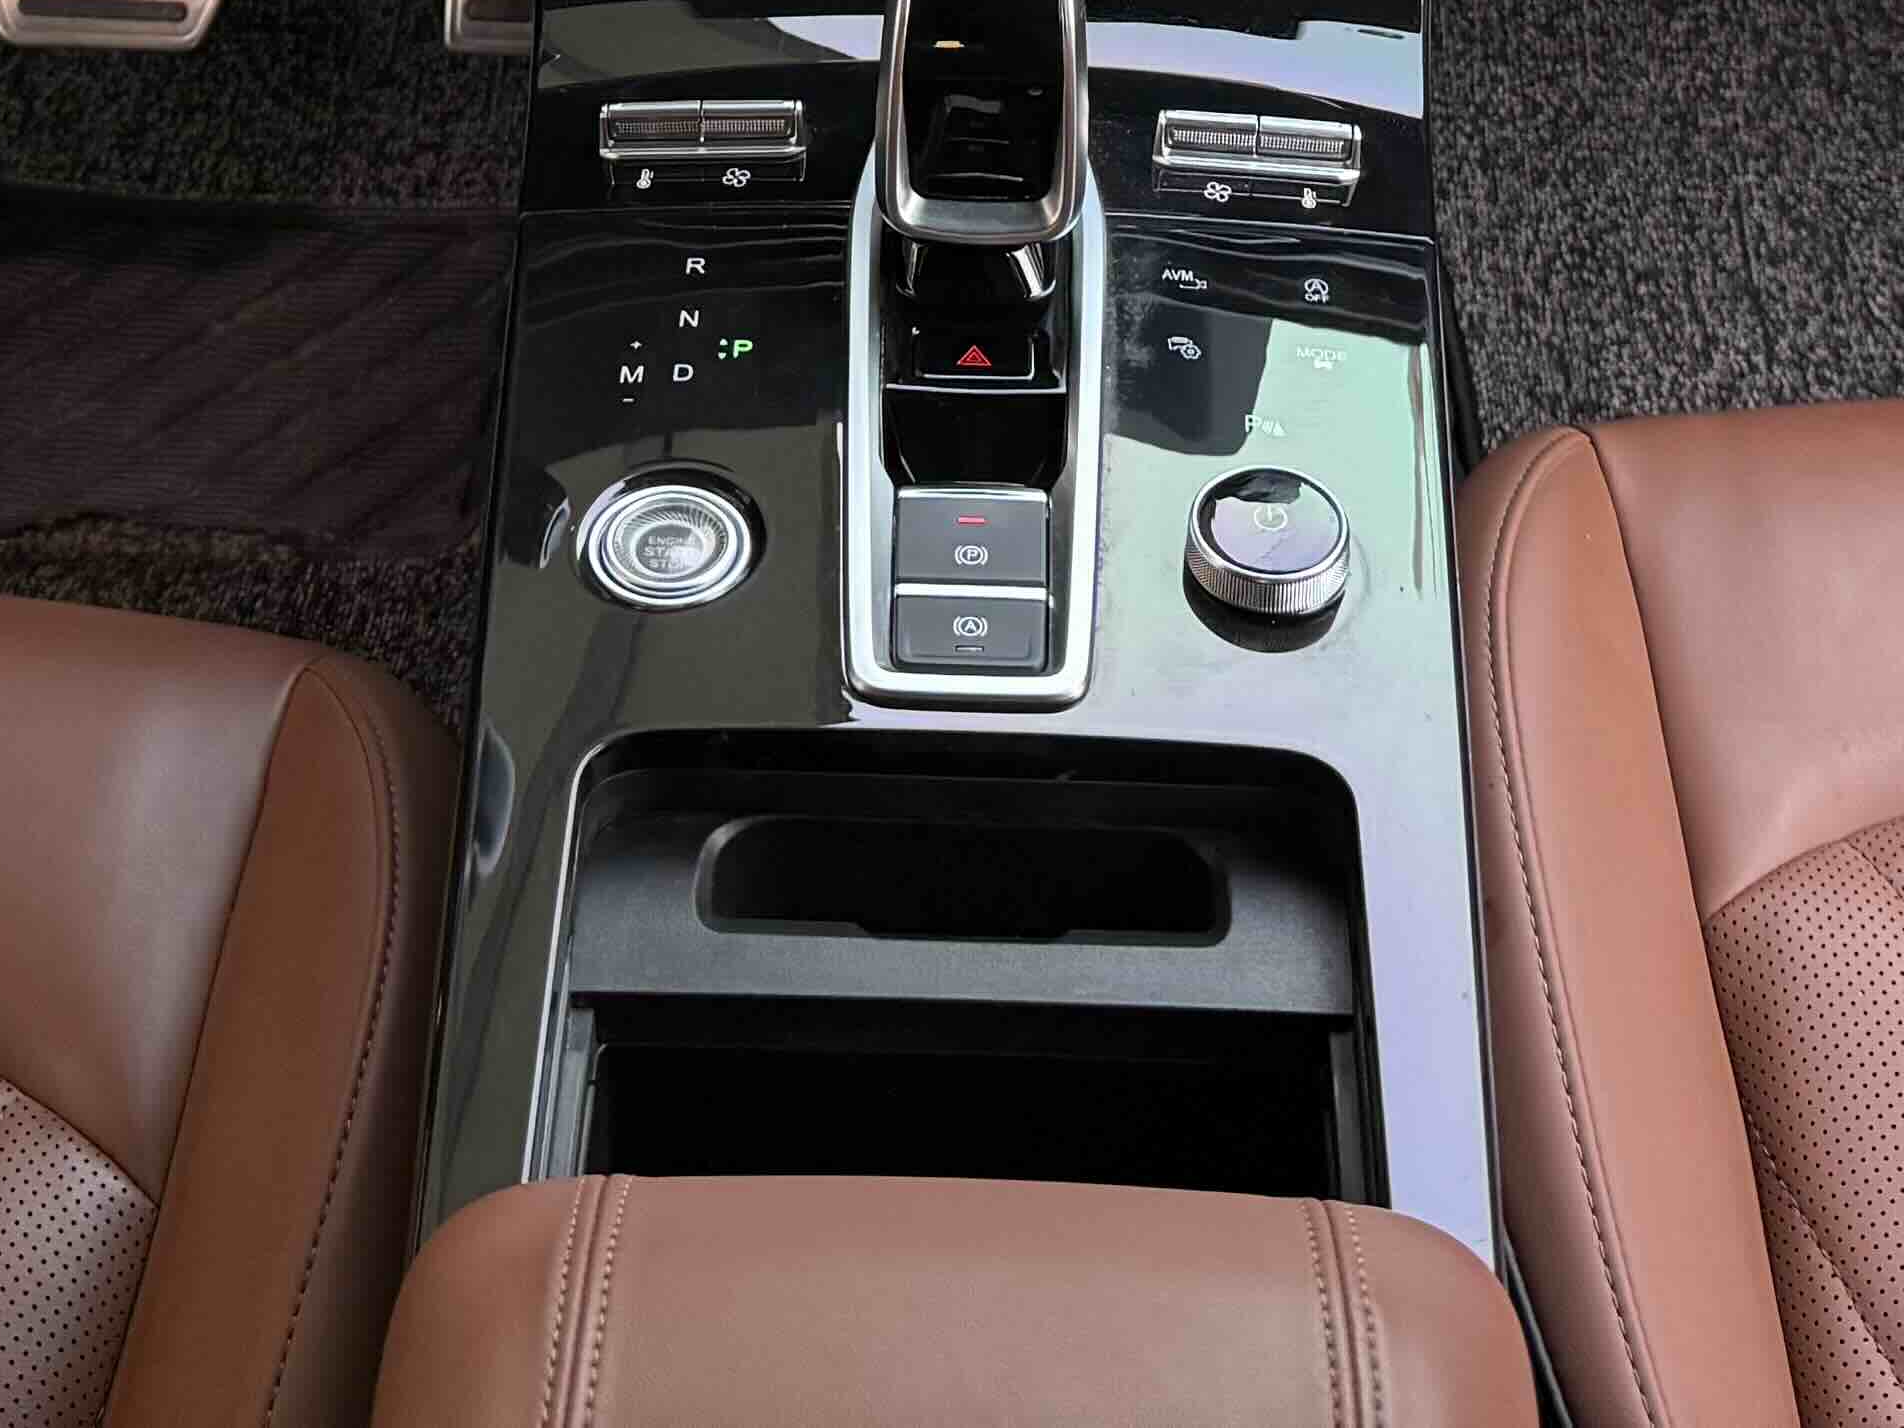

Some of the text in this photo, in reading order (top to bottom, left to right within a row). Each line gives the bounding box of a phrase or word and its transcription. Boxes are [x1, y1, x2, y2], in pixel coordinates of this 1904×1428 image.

[685, 257, 706, 275] R
[1162, 268, 1194, 282] AVM
[679, 309, 700, 328] N
[732, 339, 754, 359] P
[619, 364, 645, 384] M
[672, 363, 694, 382] D
